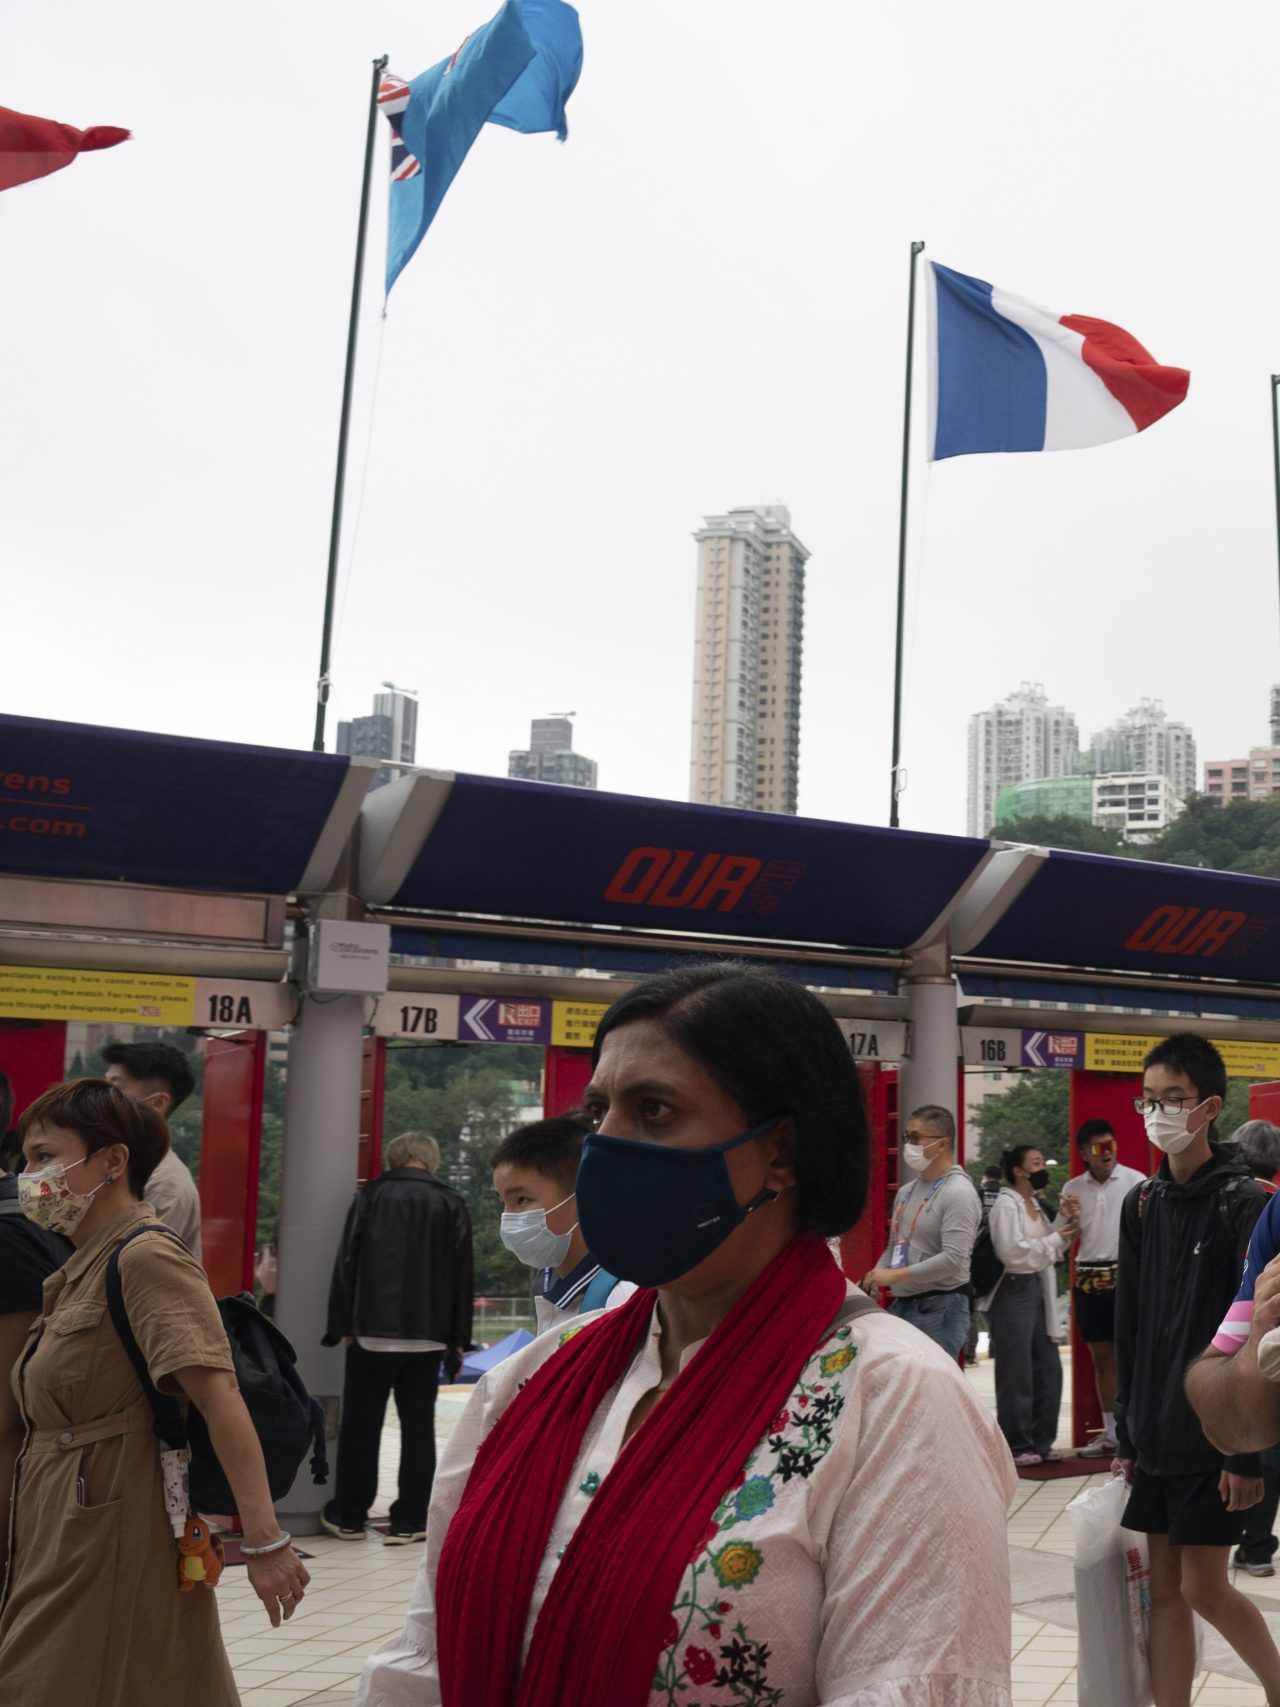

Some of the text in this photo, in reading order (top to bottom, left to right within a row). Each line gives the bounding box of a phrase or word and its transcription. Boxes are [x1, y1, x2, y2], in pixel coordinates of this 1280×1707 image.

[0, 772, 71, 795] ens
[603, 846, 762, 913] OUR
[1123, 905, 1246, 958] OUR
[0, 971, 41, 980] pectators
[209, 994, 253, 1024] 18A
[401, 1005, 437, 1034] 17B
[850, 1032, 879, 1057] 17A
[980, 1039, 1006, 1061] 16B
